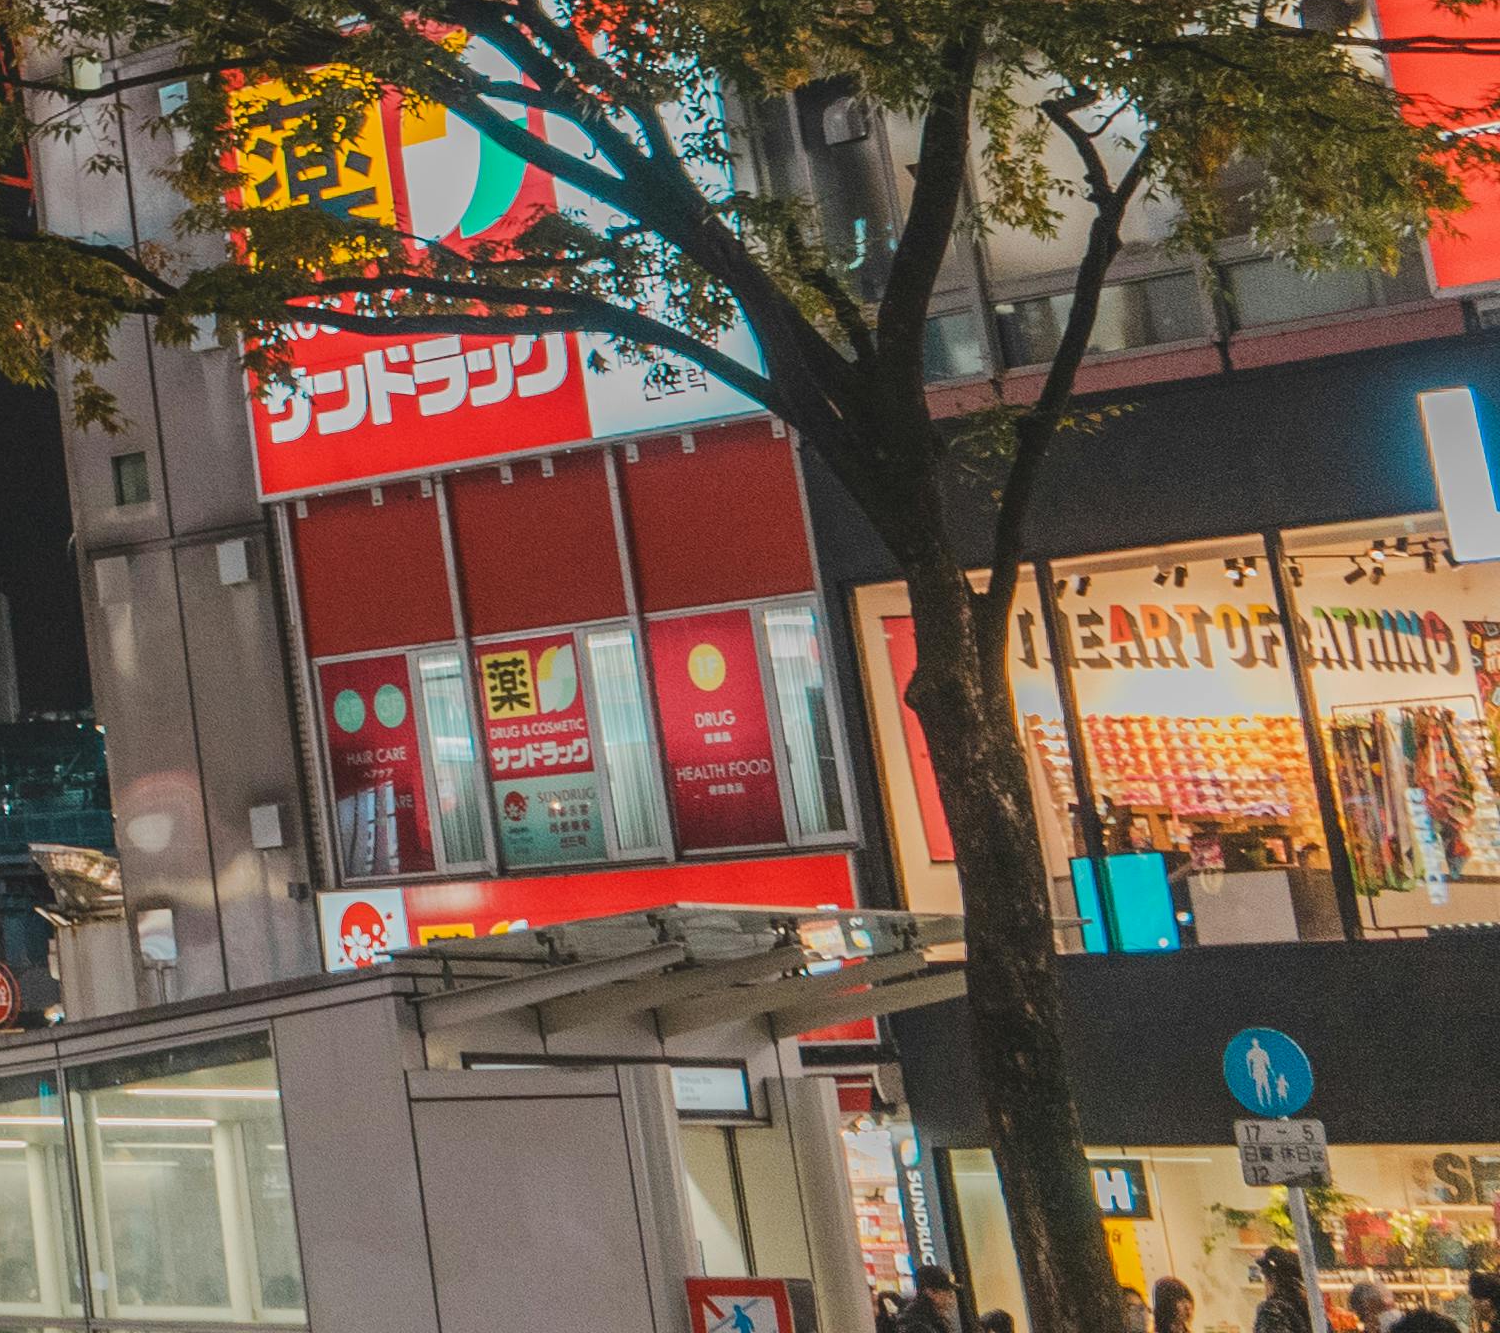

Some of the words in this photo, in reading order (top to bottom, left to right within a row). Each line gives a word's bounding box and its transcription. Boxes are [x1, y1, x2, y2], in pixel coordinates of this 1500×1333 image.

[264, 331, 569, 444] サンドラッグ
[485, 657, 531, 713] 薬
[490, 724, 520, 740] DRUG
[531, 717, 586, 735] COSMETIC
[693, 709, 737, 729] DRUG
[347, 749, 374, 766] HAIR
[375, 746, 407, 763] CARE
[491, 737, 589, 771] サンドラッグ
[676, 763, 726, 782] HEALTH
[728, 759, 772, 777] FOOD
[1244, 1124, 1261, 1142] 17
[1302, 1123, 1315, 1141] 5
[1252, 1166, 1270, 1184] 12
[905, 1170, 938, 1267] SUNDRUG
